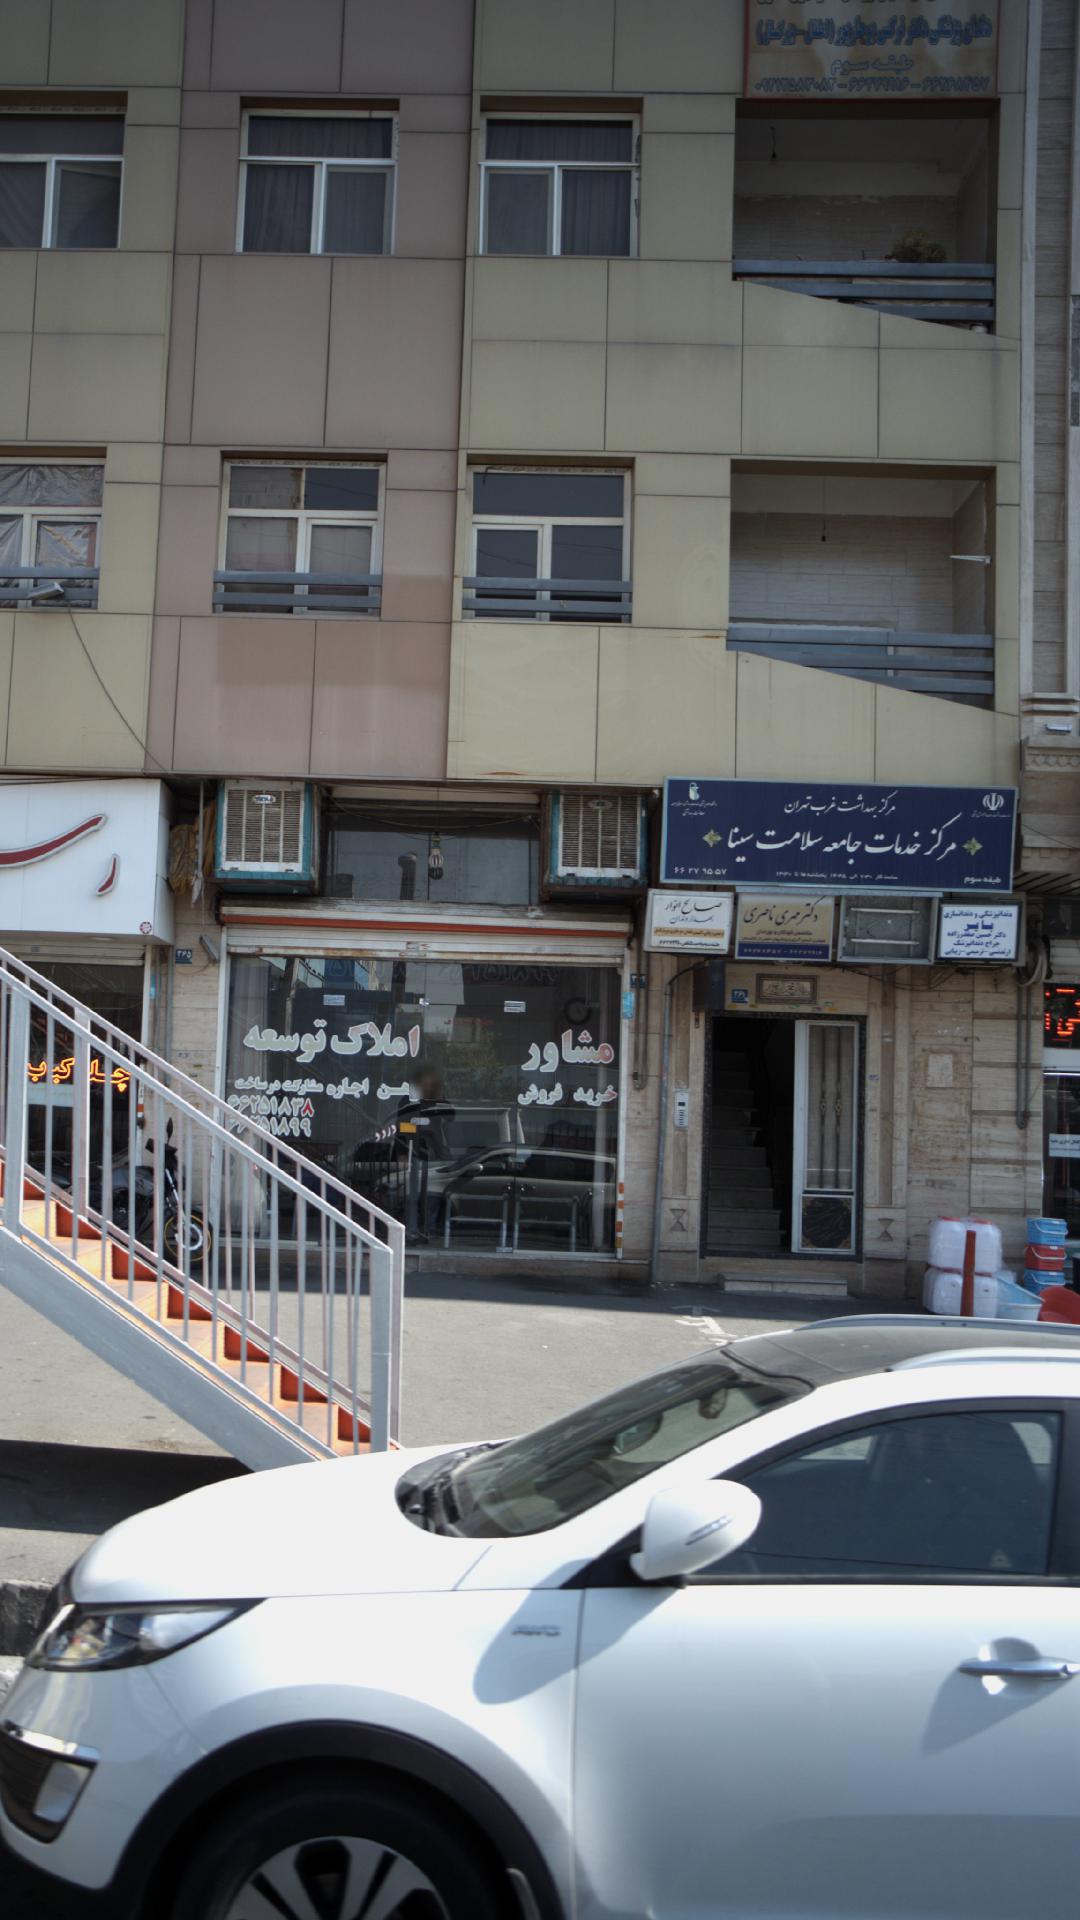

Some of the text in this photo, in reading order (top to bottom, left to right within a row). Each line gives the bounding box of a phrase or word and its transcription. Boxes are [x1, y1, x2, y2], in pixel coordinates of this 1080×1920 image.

[831, 59, 870, 76] سوم
[783, 790, 899, 818] مرکز بهداشت غرب تهران
[727, 811, 963, 865] مرکز خدمات جامعه سلامت سینا
[743, 904, 777, 925] ناصری
[796, 895, 826, 926] دکتر
[243, 1019, 615, 1073] مشاور املاک توسعه
[281, 1078, 324, 1096] مشارکت
[326, 1077, 370, 1099] اجاره
[517, 1082, 563, 1106] فروش
[573, 1084, 618, 1107] خرید
